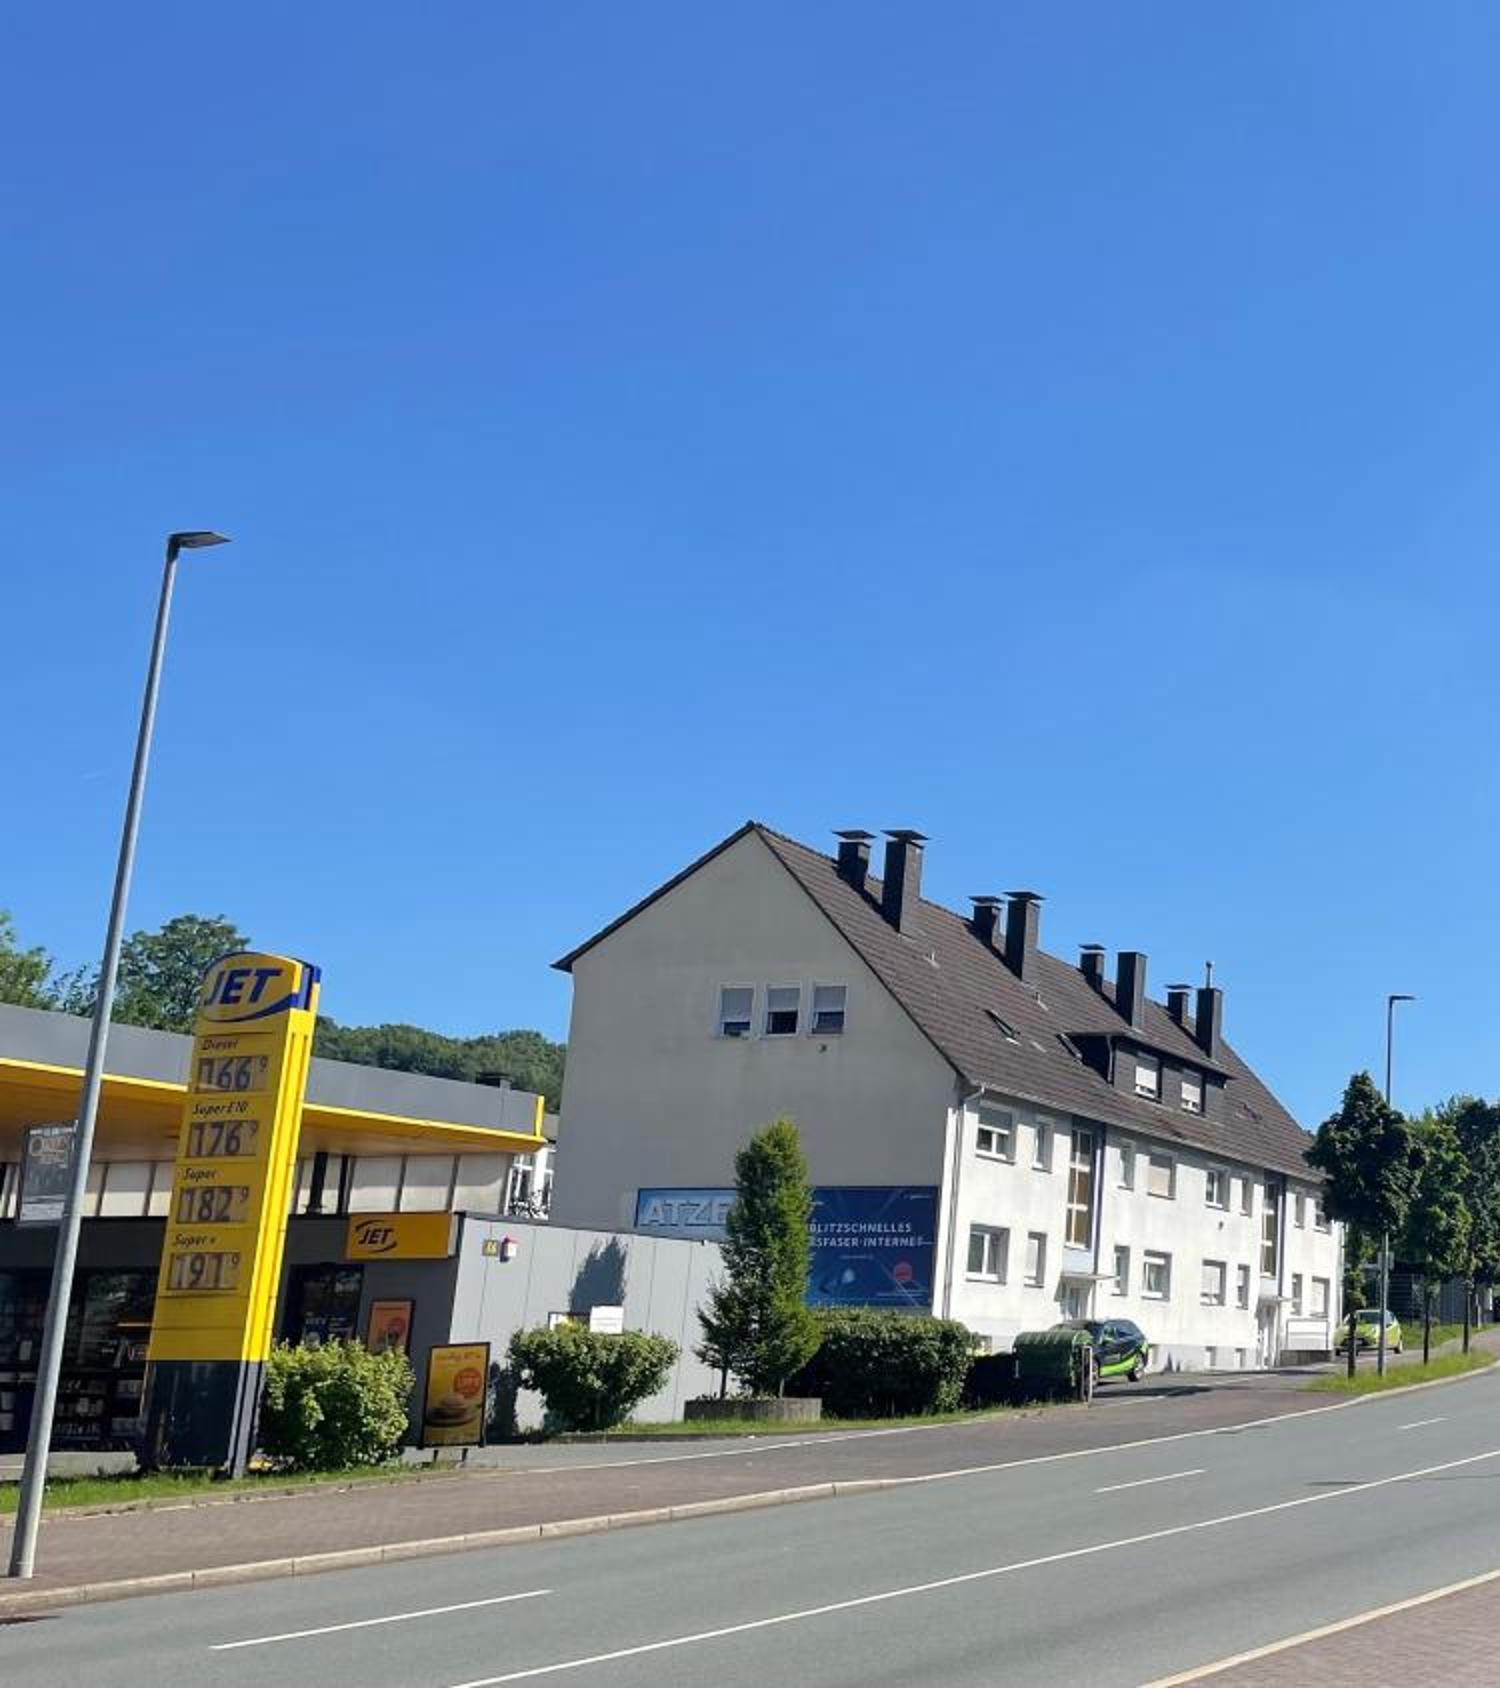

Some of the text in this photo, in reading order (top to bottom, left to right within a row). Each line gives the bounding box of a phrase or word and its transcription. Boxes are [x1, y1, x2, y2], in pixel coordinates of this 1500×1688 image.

[204, 968, 282, 1006] JET
[202, 1039, 239, 1051] Diesel
[184, 1167, 217, 1182] Super
[174, 1233, 206, 1248] Super
[359, 1228, 394, 1245] JET
